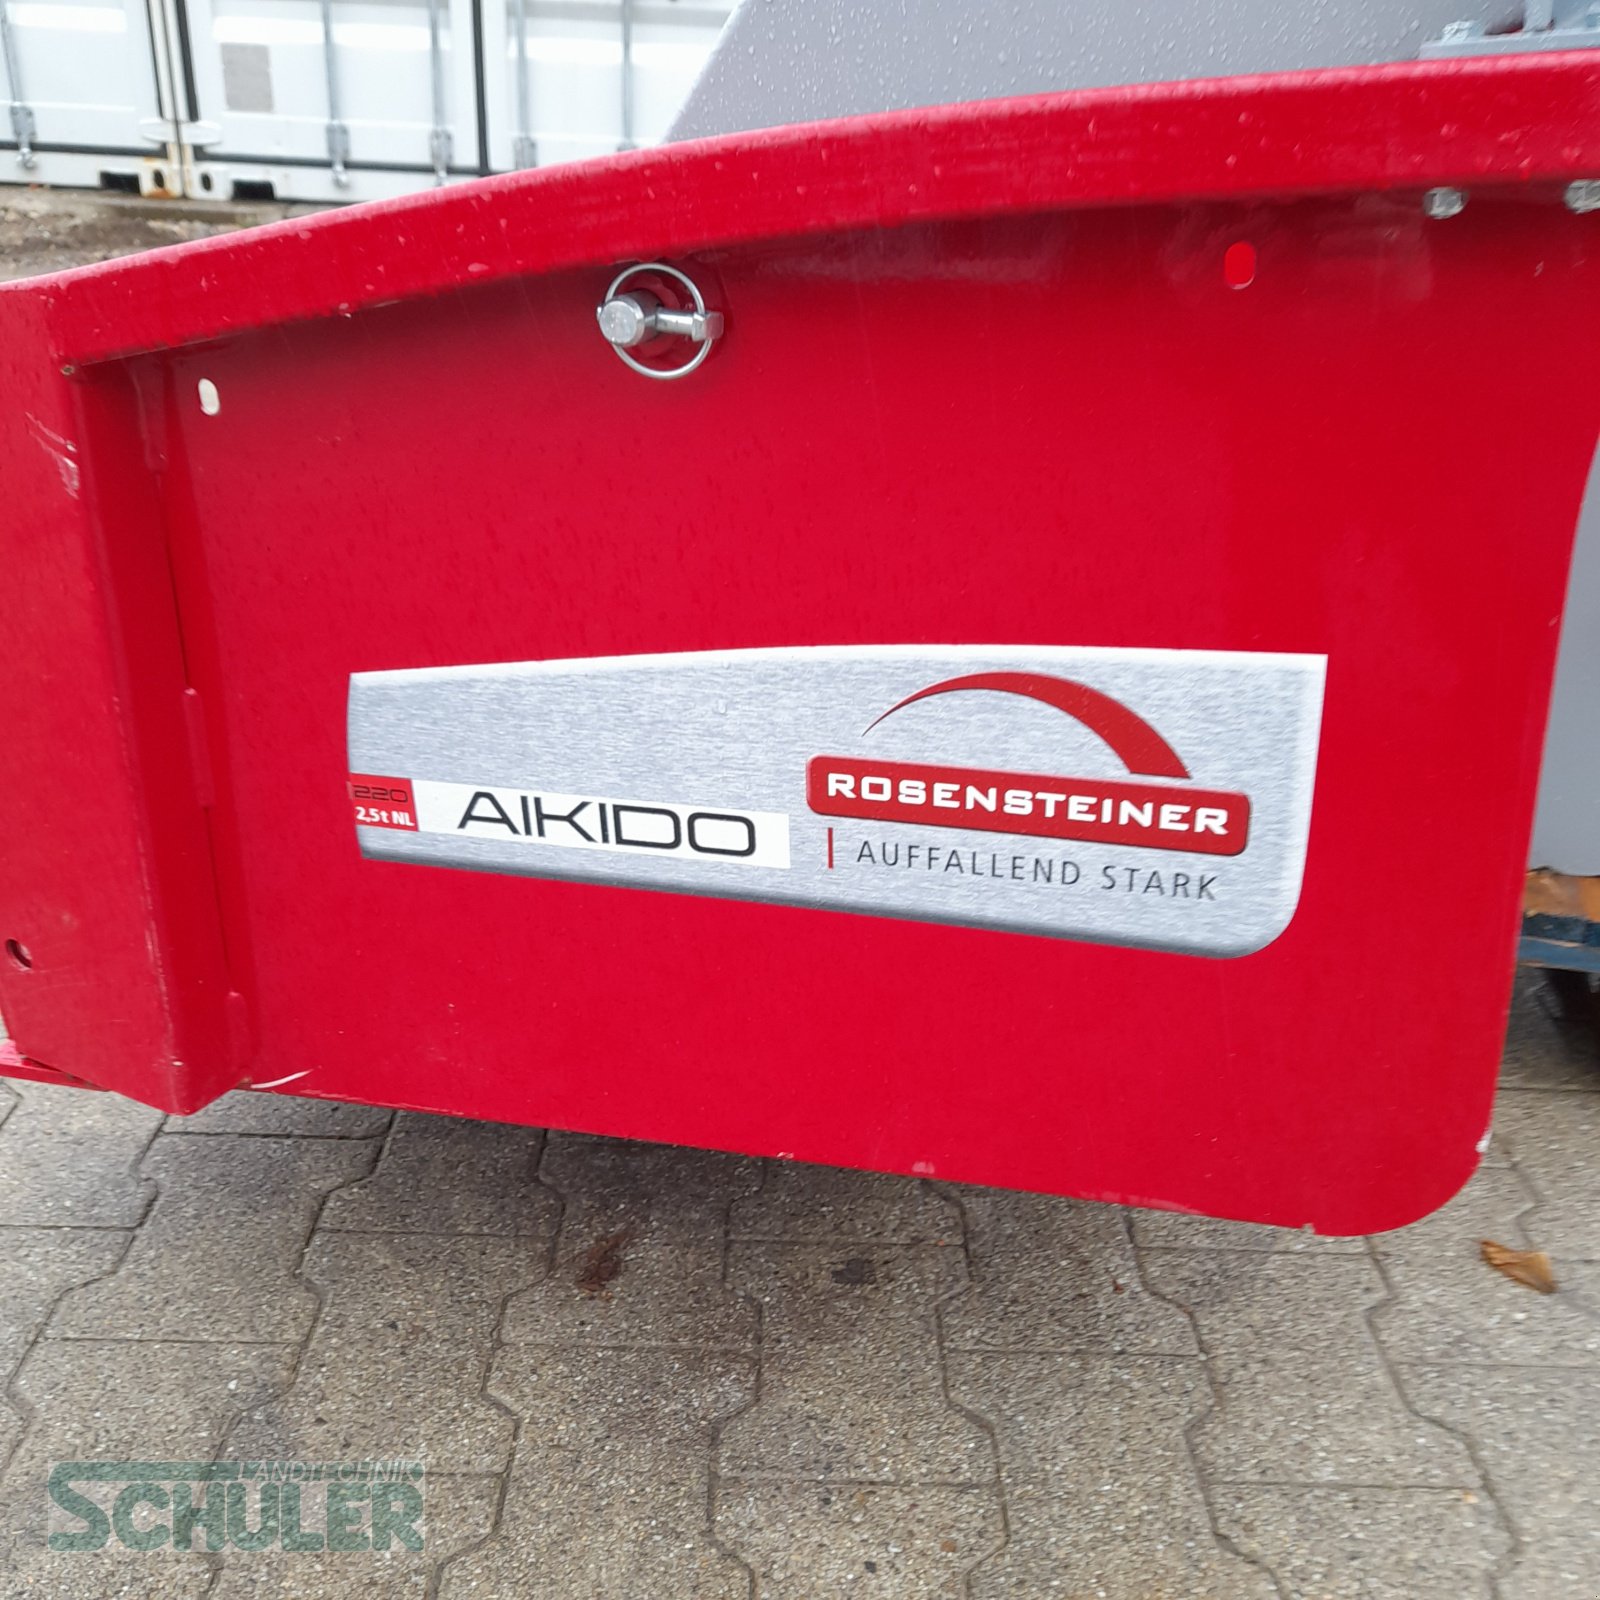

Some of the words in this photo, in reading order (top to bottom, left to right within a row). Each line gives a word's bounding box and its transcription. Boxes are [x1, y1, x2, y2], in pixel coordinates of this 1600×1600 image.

[352, 784, 409, 803] 220
[391, 810, 415, 827] NL
[457, 791, 757, 857] AIKIDO
[826, 772, 1229, 836] ROSENSTEINER
[856, 840, 1081, 886] AUFFALLEND
[1101, 866, 1218, 901] STARK
